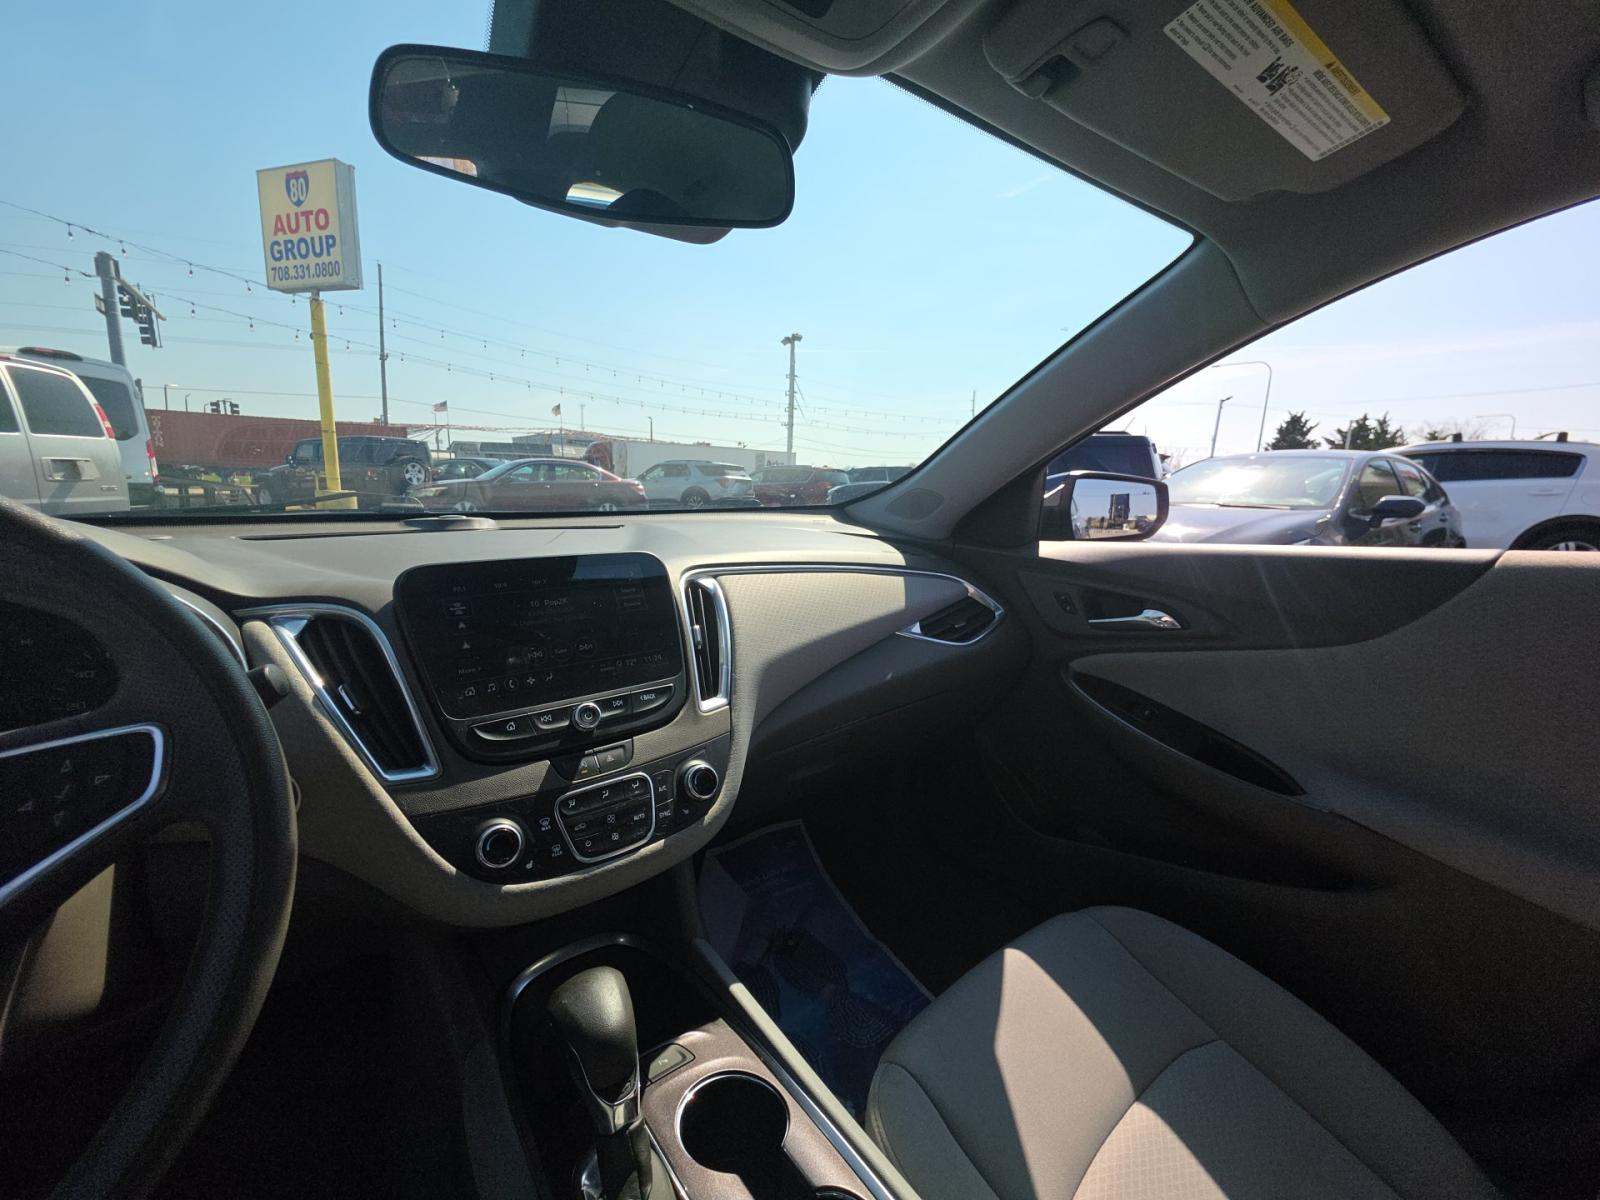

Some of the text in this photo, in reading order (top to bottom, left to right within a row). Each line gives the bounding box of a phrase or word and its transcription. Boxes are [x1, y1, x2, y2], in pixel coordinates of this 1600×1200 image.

[289, 178, 307, 203] 80
[273, 208, 330, 236] AUTO
[270, 234, 337, 262] GROUP
[271, 260, 341, 281] 708.331.0800
[643, 693, 656, 701] BACK
